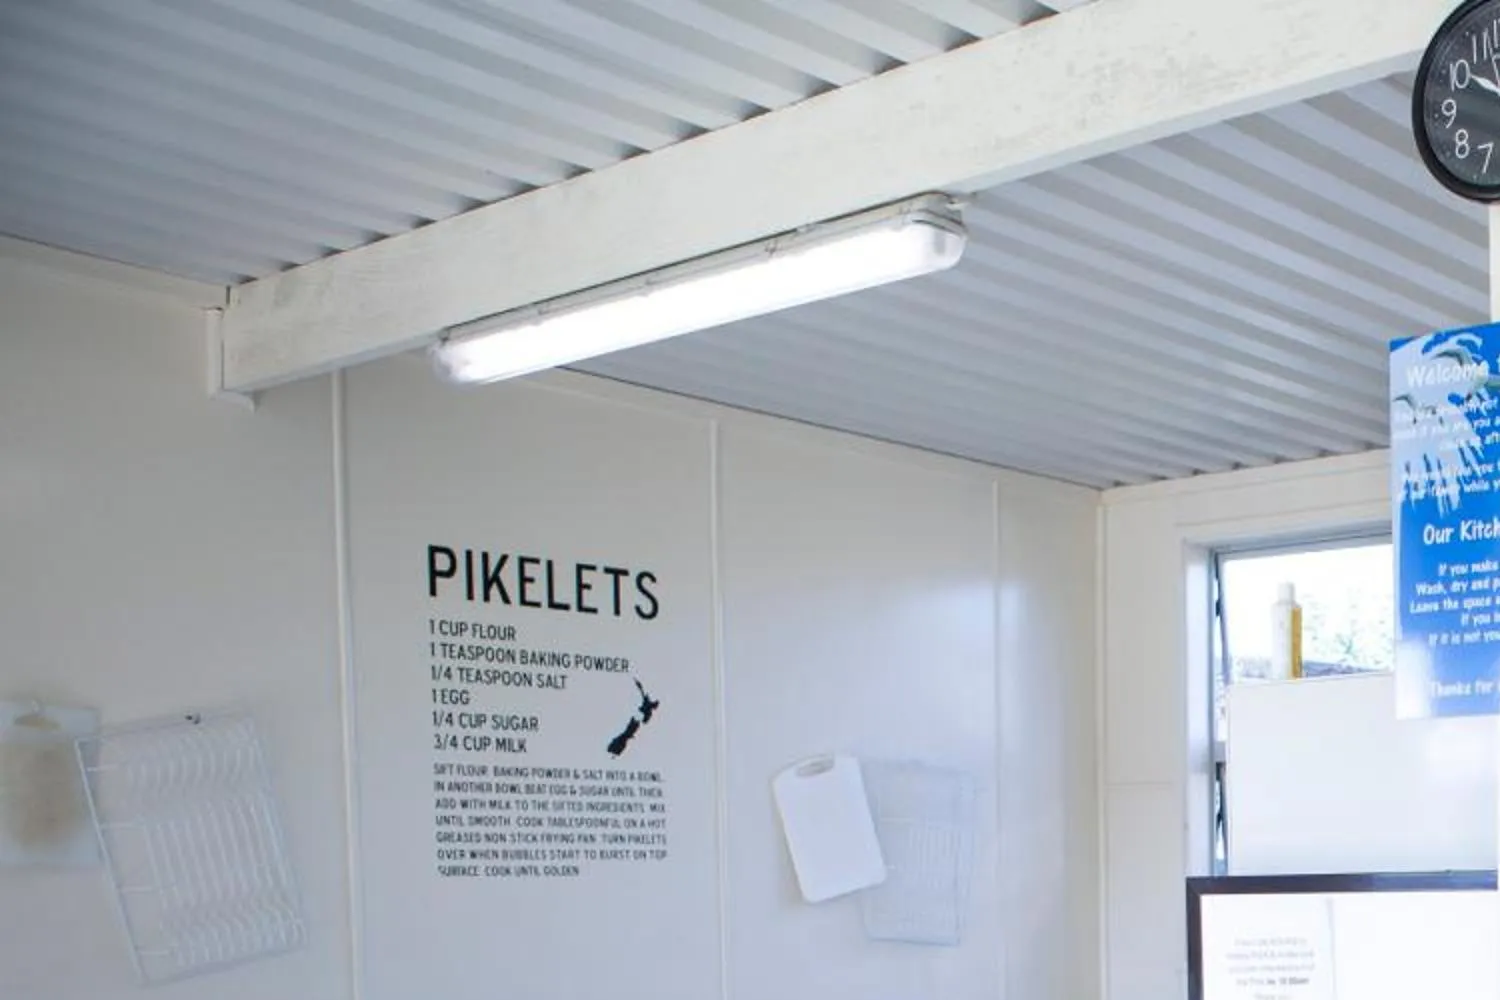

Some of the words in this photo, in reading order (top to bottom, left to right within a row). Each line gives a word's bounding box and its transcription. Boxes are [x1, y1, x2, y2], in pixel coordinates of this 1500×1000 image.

[1471, 28, 1489, 64] 11
[1449, 59, 1470, 92] 10
[1441, 98, 1457, 129] 9
[1455, 128, 1470, 160] 8
[1478, 142, 1494, 174] 7
[1406, 361, 1490, 388] Welcome
[1423, 523, 1455, 546] Our
[427, 544, 660, 621] PIKELETS
[438, 619, 469, 638] CUP
[471, 623, 517, 642] FLOUR
[440, 643, 517, 665] TEASPOON
[520, 650, 571, 670] BAKING
[574, 653, 629, 673] POWDER
[431, 665, 452, 681] 1/4
[457, 667, 533, 688] TEASPOON
[536, 673, 568, 690] SALT
[441, 689, 471, 705] EGG
[432, 711, 454, 728] 1/4
[458, 712, 487, 729] CUP
[491, 714, 539, 732] SUGAR
[433, 734, 459, 751] 3/4
[462, 735, 492, 752] CUP
[495, 737, 527, 753] MILK
